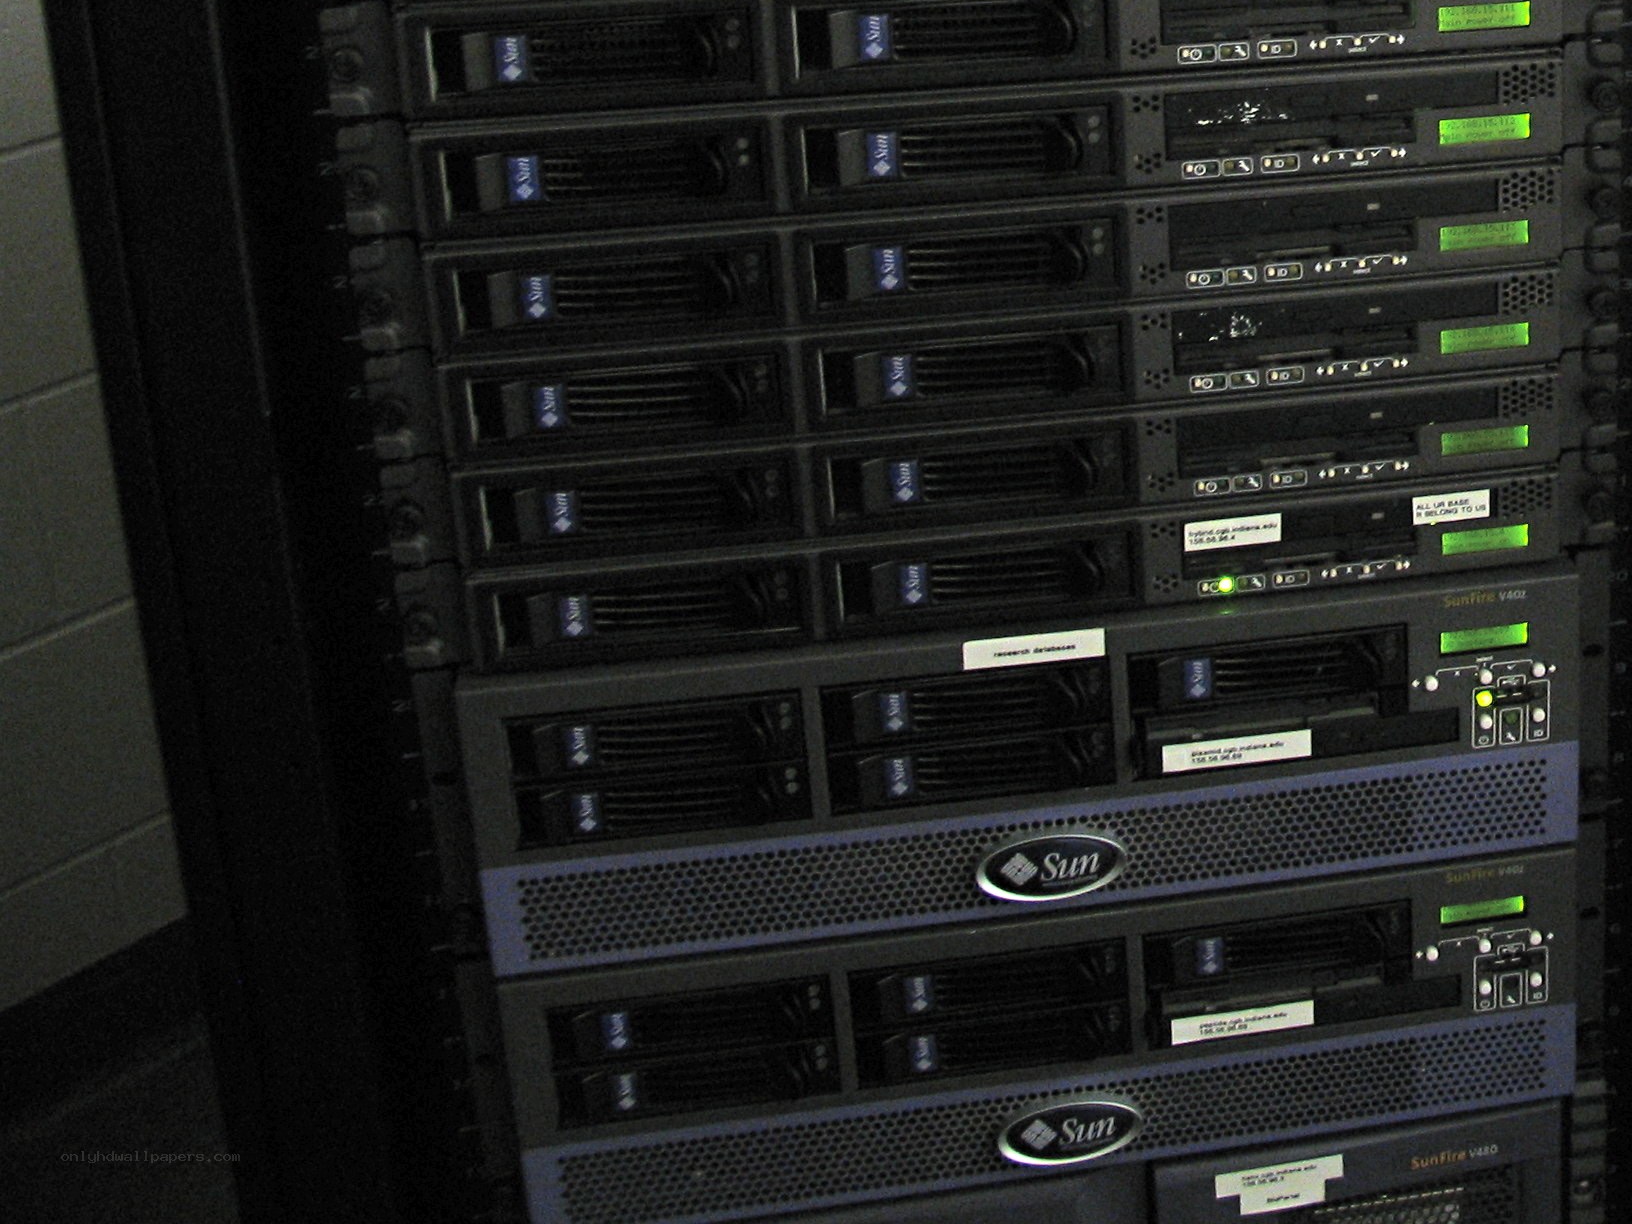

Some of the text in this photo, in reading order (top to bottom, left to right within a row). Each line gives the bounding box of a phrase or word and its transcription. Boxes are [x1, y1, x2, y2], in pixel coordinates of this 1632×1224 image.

[1271, 45, 1281, 53] ID
[1274, 160, 1284, 168] ID
[1280, 372, 1289, 380] ID
[1416, 502, 1431, 511] ALL
[1448, 499, 1470, 507] BASE
[1425, 508, 1458, 517] BELONG
[993, 647, 1030, 658] research
[1040, 851, 1100, 881] Sun
[1060, 1114, 1115, 1144] Sun
